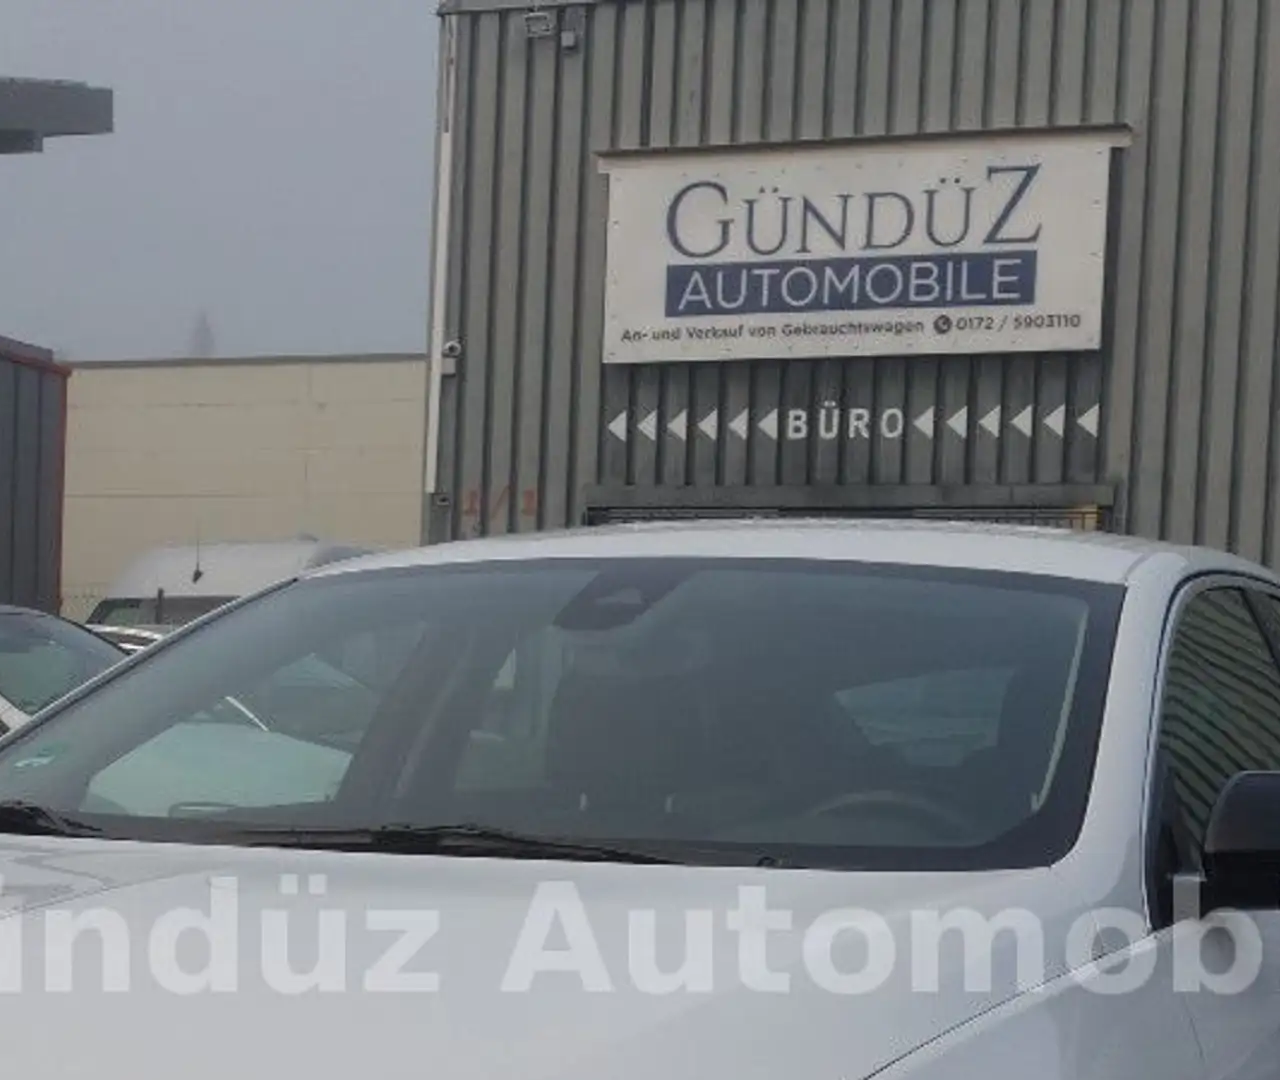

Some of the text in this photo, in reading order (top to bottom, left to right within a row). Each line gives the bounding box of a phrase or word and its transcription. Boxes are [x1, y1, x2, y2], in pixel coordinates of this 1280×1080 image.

[677, 257, 1023, 311] AUTOMOBILE
[621, 329, 648, 342] An-
[652, 327, 682, 341] und
[687, 324, 745, 338] Verkauf
[748, 326, 777, 338] von
[956, 315, 994, 331] 0172
[1013, 313, 1082, 330] 5903110
[787, 401, 903, 439] BÜRO
